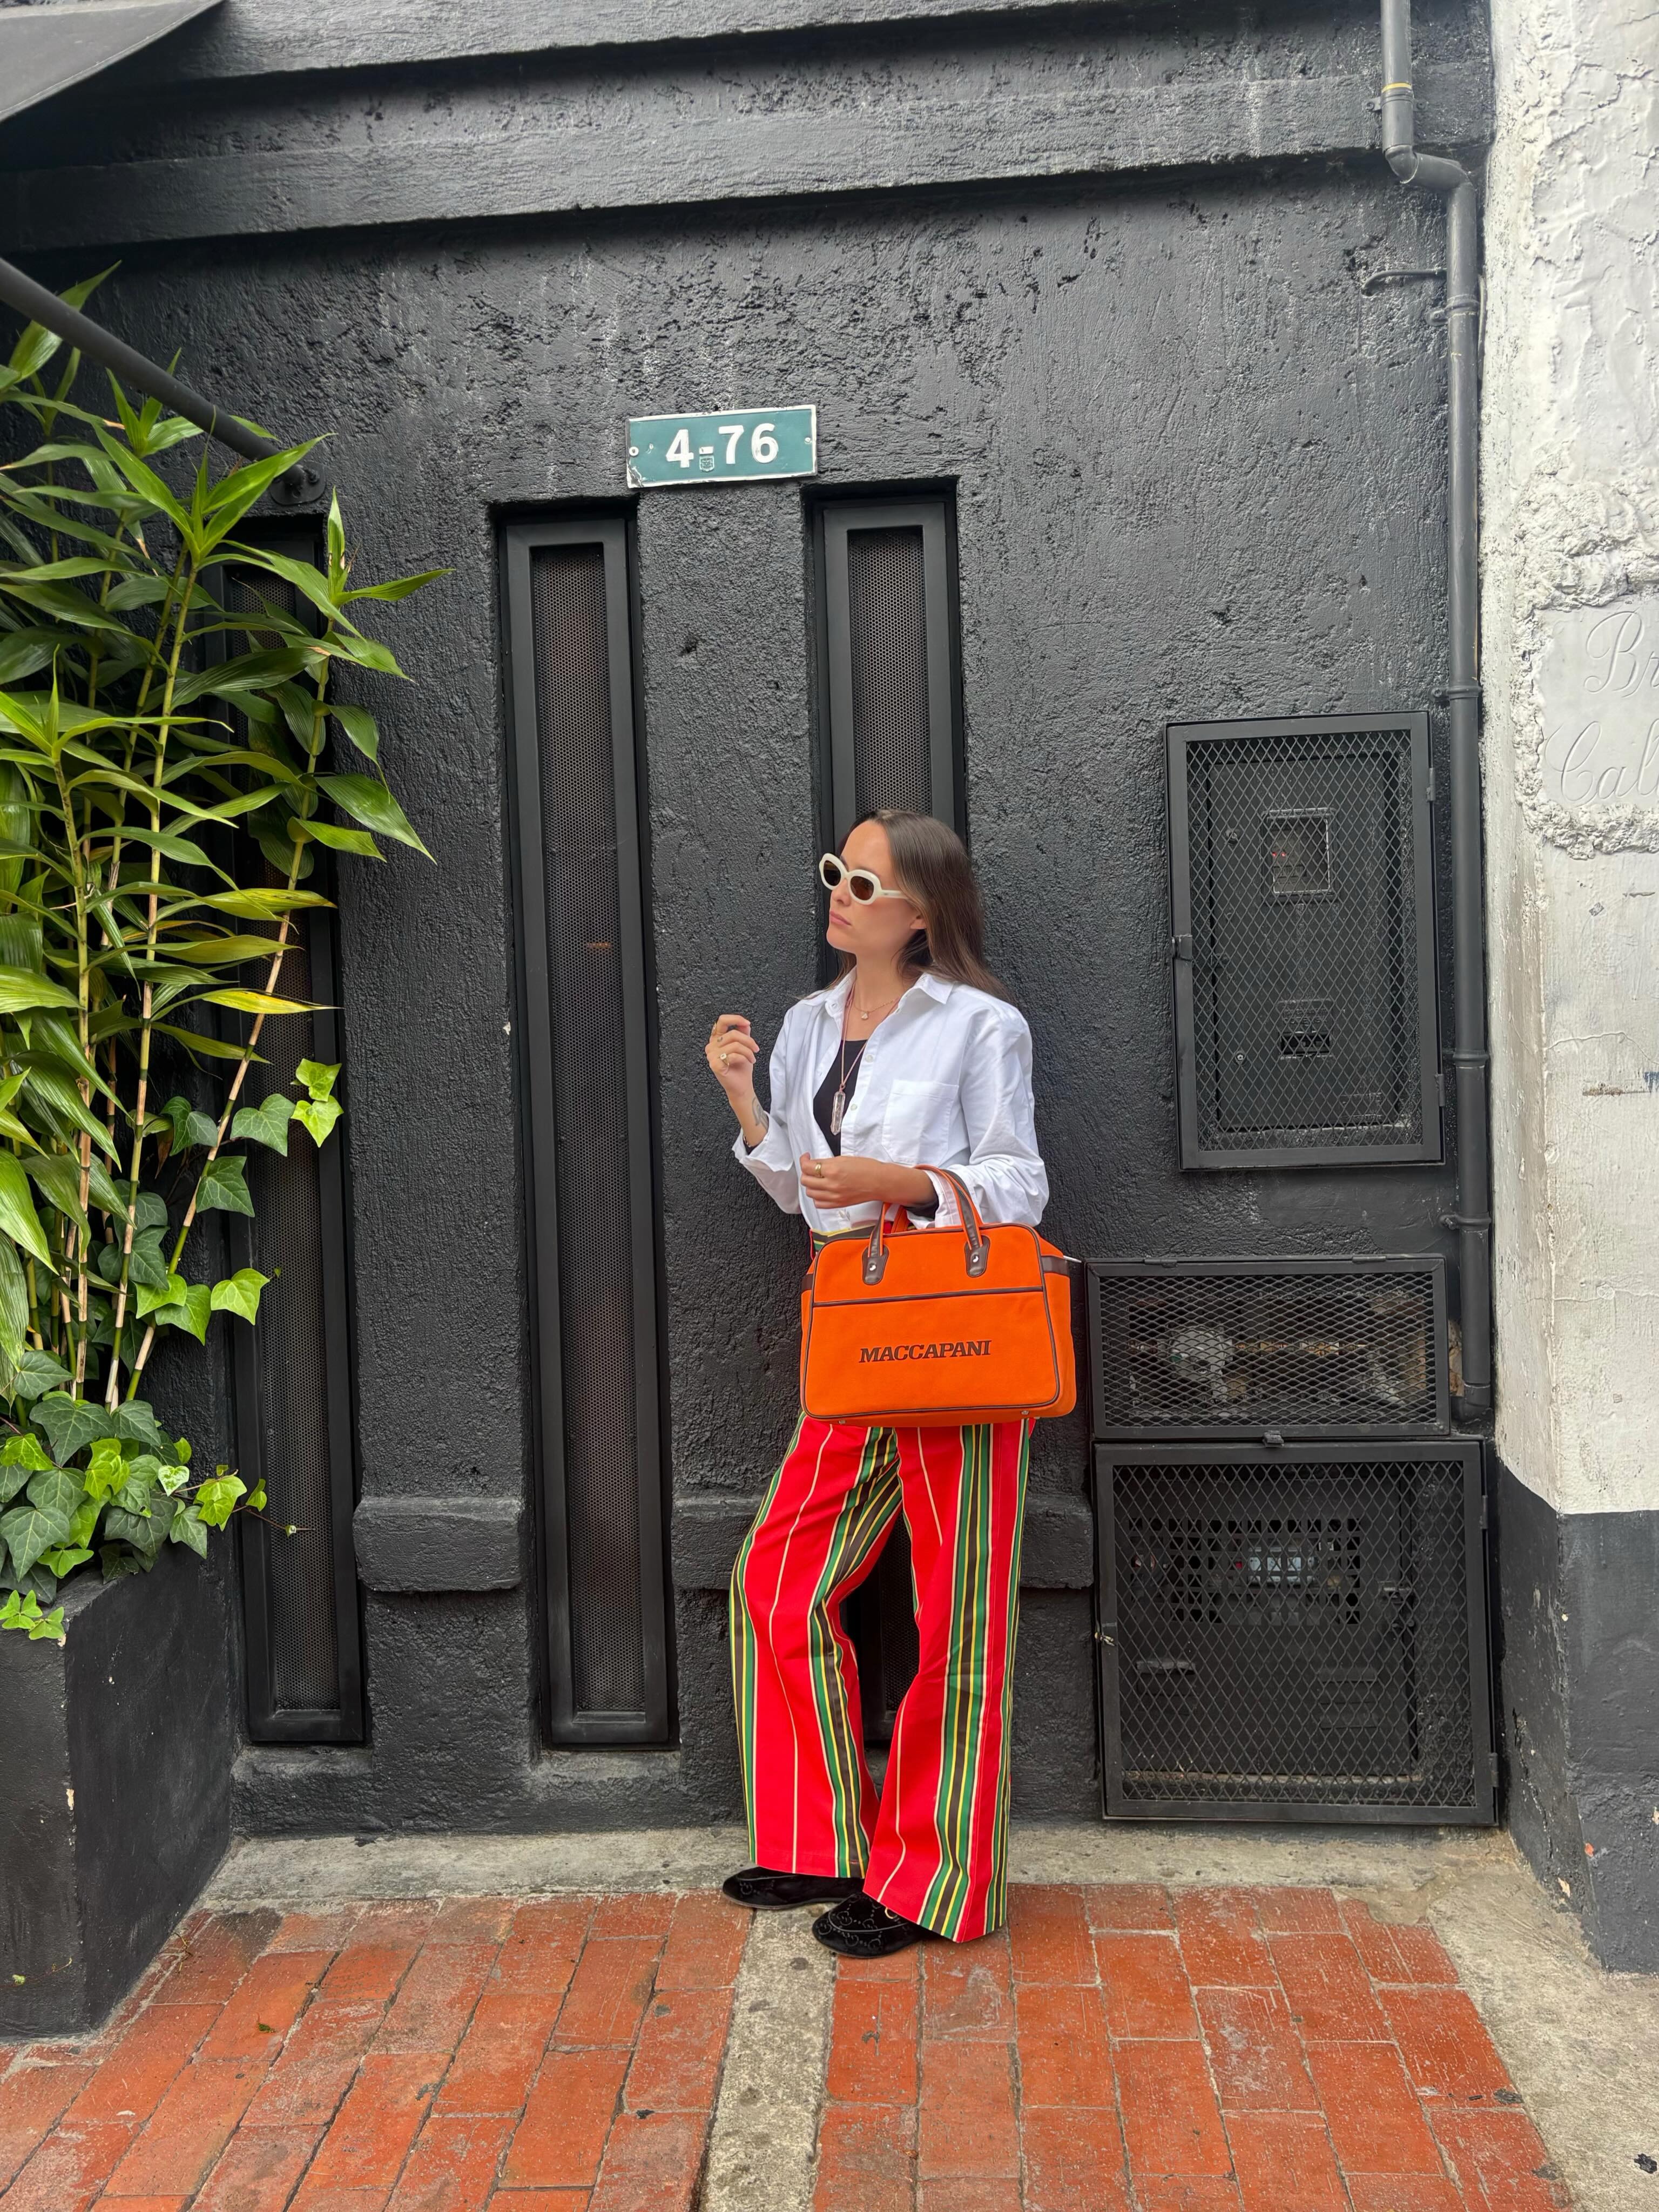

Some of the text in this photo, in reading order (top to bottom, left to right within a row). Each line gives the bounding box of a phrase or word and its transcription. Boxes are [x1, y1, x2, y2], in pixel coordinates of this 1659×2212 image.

[665, 423, 779, 468] 4-76
[1545, 718, 1659, 807] Cal
[859, 1340, 992, 1363] MACCAPANI
